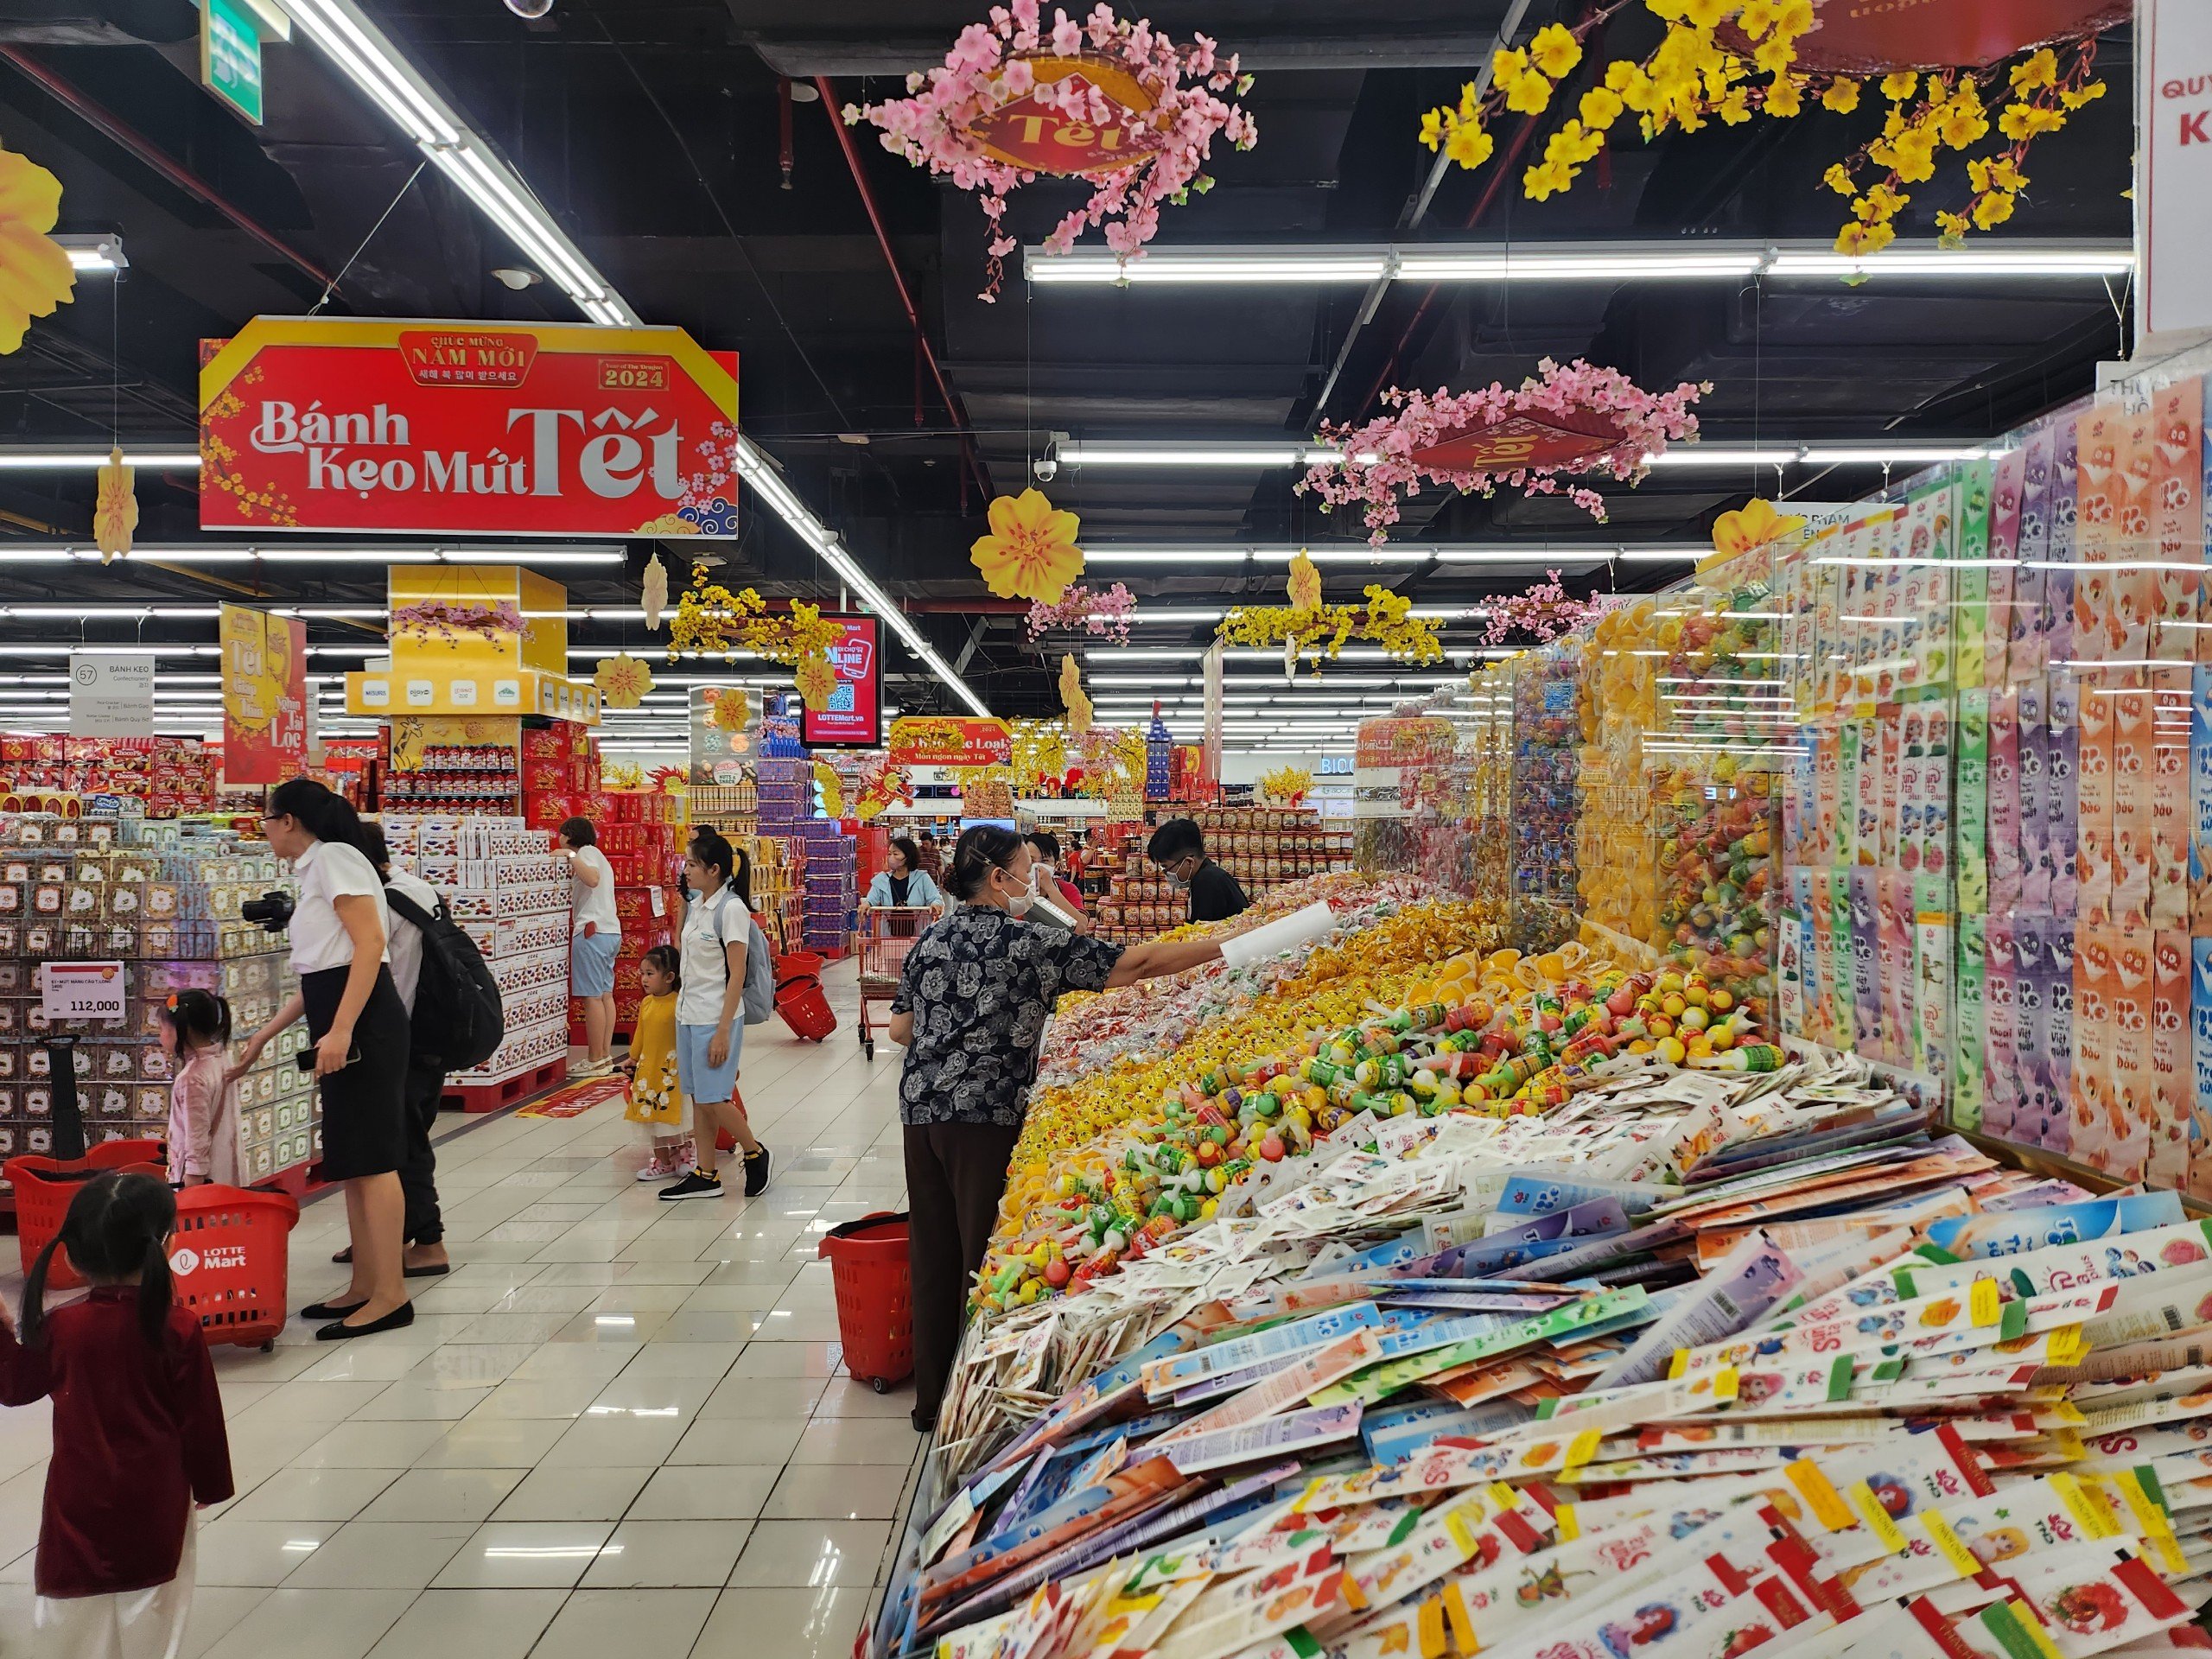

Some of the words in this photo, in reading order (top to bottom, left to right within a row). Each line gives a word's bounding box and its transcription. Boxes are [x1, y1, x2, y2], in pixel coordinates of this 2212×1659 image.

[431, 336, 465, 346] CHÚC
[469, 336, 503, 347] MỪNG
[412, 343, 467, 365] NĂM
[477, 346, 525, 368] MỚI
[419, 370, 439, 380] 새해
[442, 370, 451, 381] 복
[455, 370, 474, 381] 많이
[478, 371, 517, 382] 받으세요
[606, 370, 664, 388] 2024
[250, 399, 410, 454] Bánh
[308, 448, 416, 499] Kẹo
[423, 447, 529, 495] Mứt
[506, 406, 689, 499] Tết
[1471, 434, 1540, 468] Tết
[228, 639, 263, 677] Tết
[79, 670, 93, 680] 57
[288, 709, 303, 731] Tài
[270, 717, 302, 753] Lộc
[71, 1001, 119, 1013] 112,000
[203, 1246, 245, 1257] LOTTE
[204, 1255, 246, 1270] Mart
